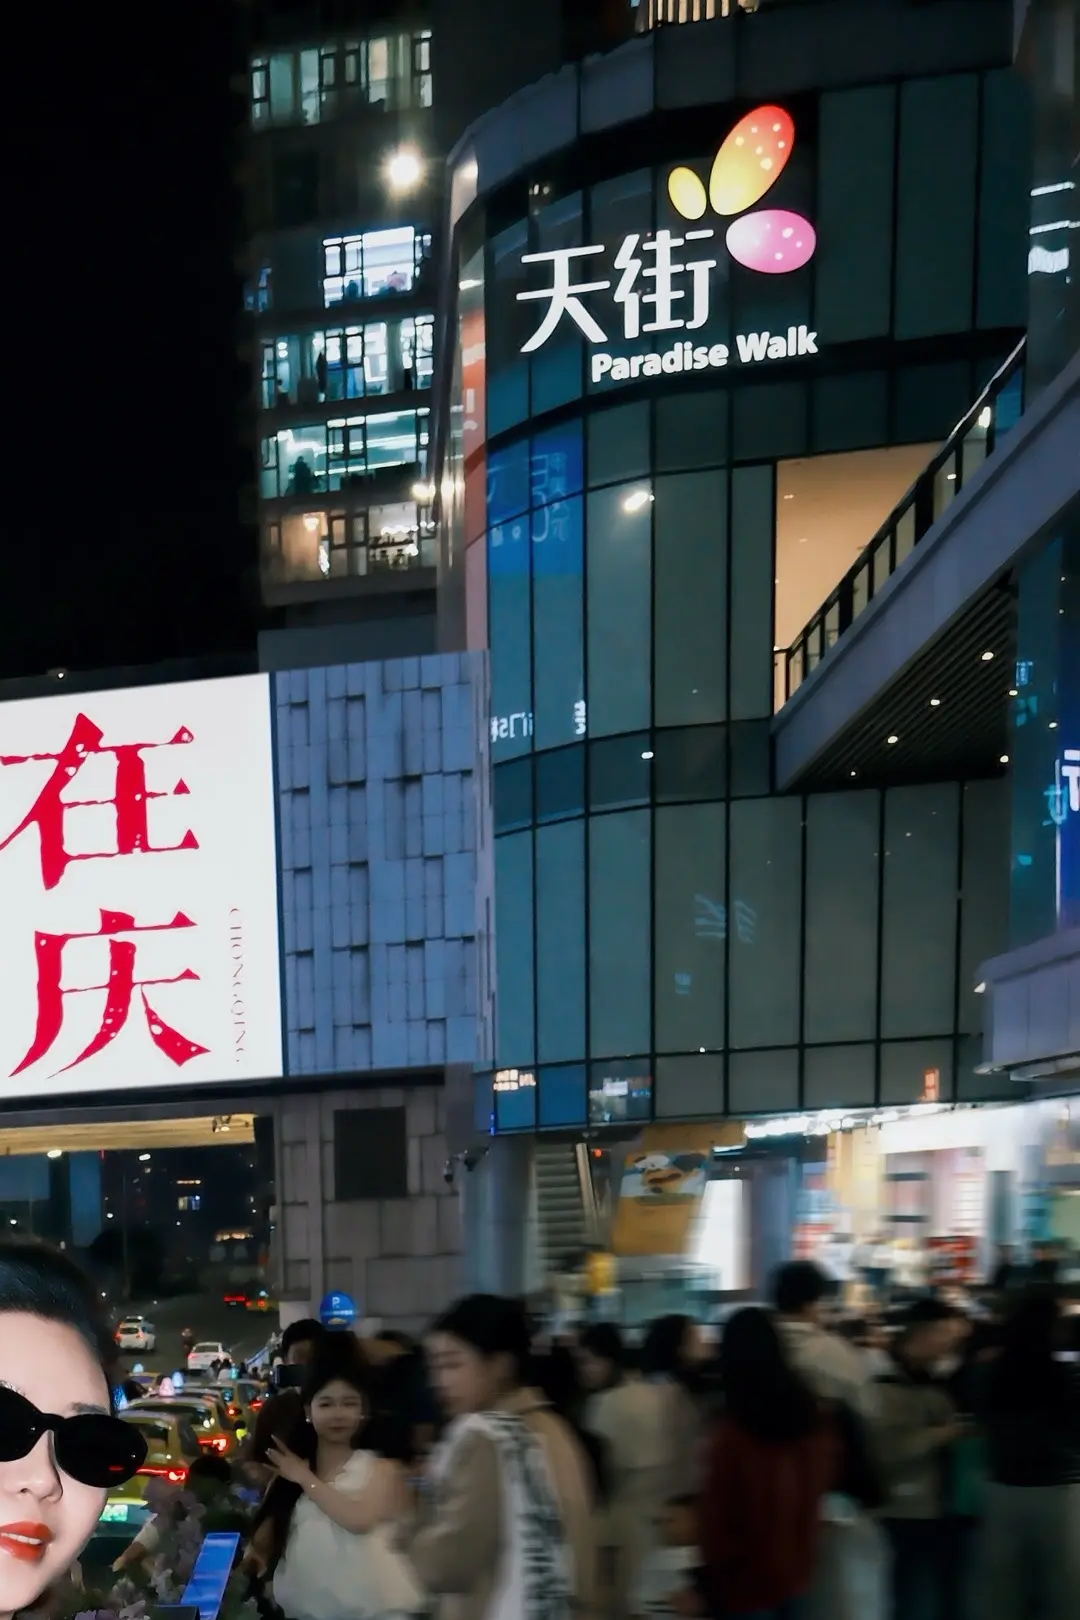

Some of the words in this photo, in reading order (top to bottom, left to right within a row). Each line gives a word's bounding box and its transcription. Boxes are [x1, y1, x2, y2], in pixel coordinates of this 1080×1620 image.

[516, 229, 717, 353] 天街
[591, 340, 729, 384] Paradise
[736, 325, 819, 364] Walk
